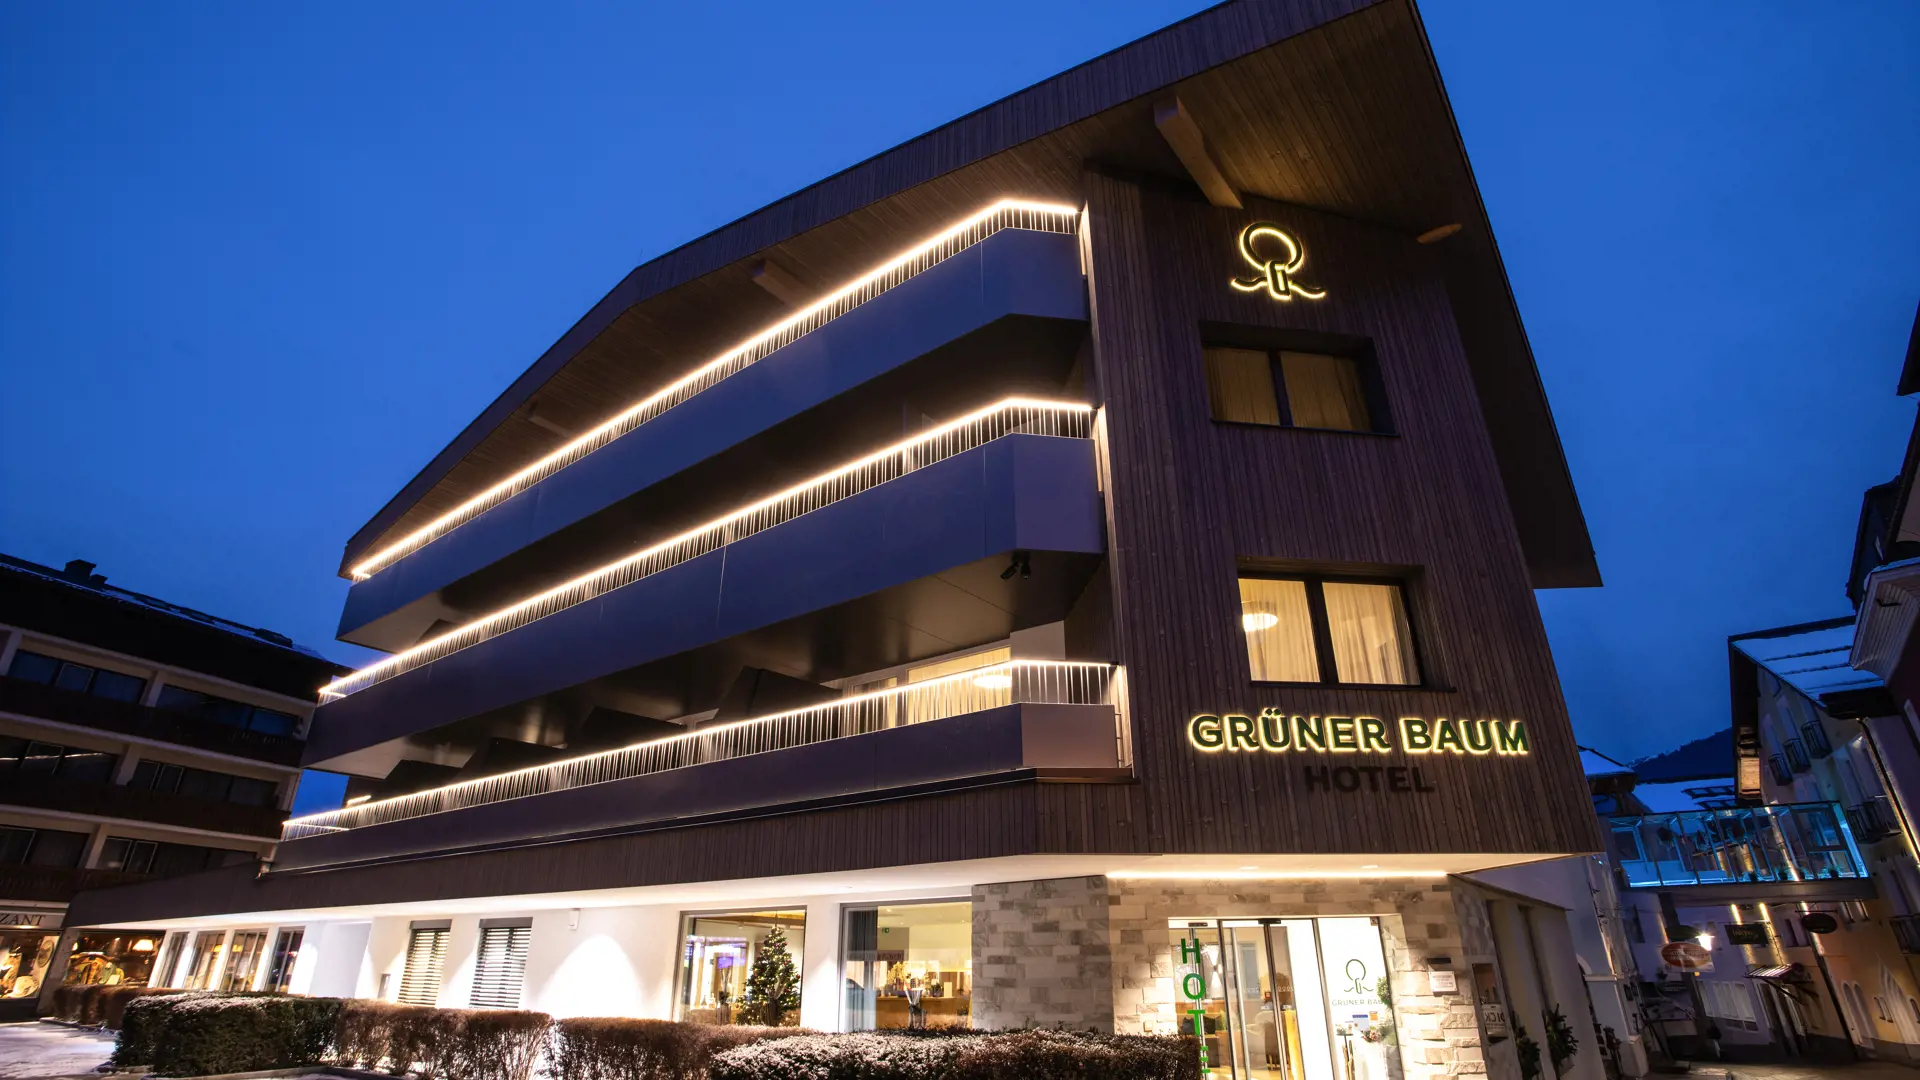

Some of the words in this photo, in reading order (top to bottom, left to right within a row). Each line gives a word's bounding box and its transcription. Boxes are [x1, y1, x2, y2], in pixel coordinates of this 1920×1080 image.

[1189, 707, 1392, 753] GRÜNER
[1400, 717, 1529, 754] BAUM
[1305, 765, 1435, 793] HOTEL
